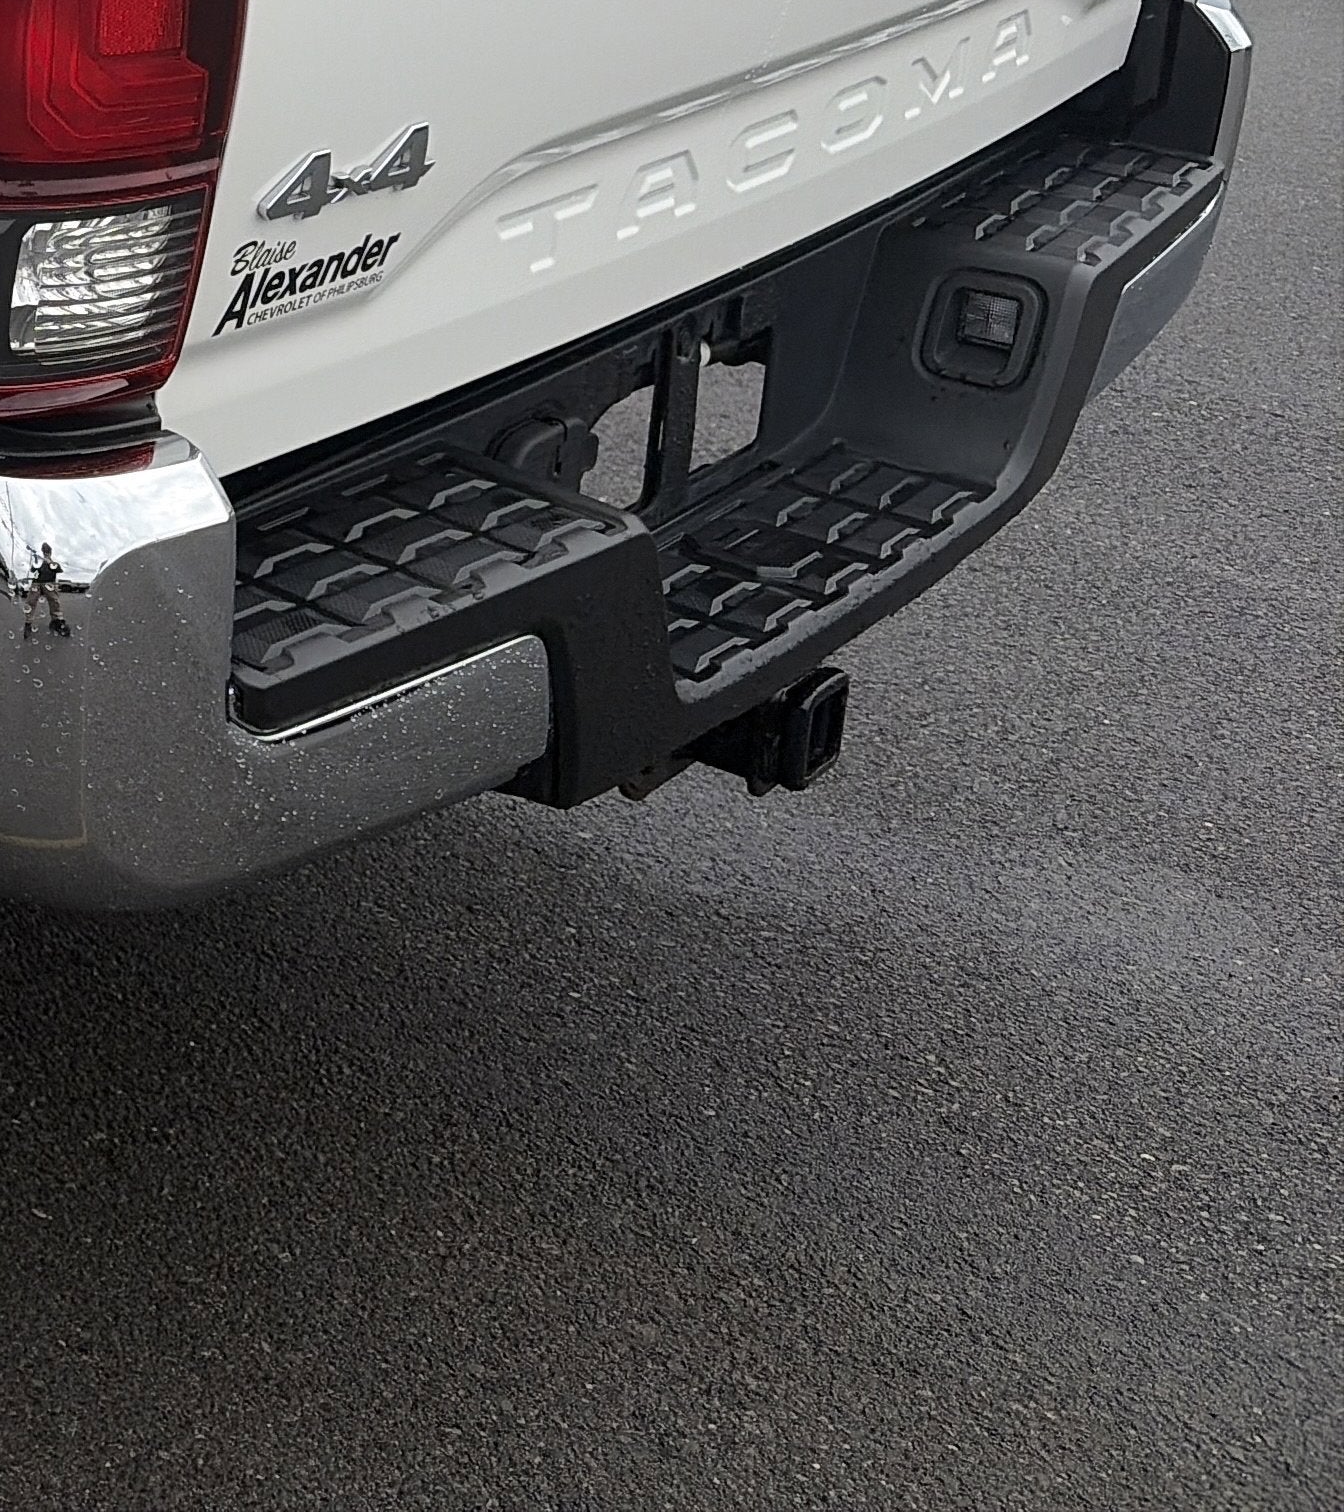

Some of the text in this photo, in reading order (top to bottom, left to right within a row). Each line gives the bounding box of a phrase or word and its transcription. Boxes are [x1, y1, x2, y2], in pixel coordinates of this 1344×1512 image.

[496, 8, 1034, 273] TACOMA
[211, 231, 402, 337] Alexander
[230, 239, 297, 277] Blaise
[246, 296, 312, 325] CHEVROLET
[312, 290, 326, 305] OF
